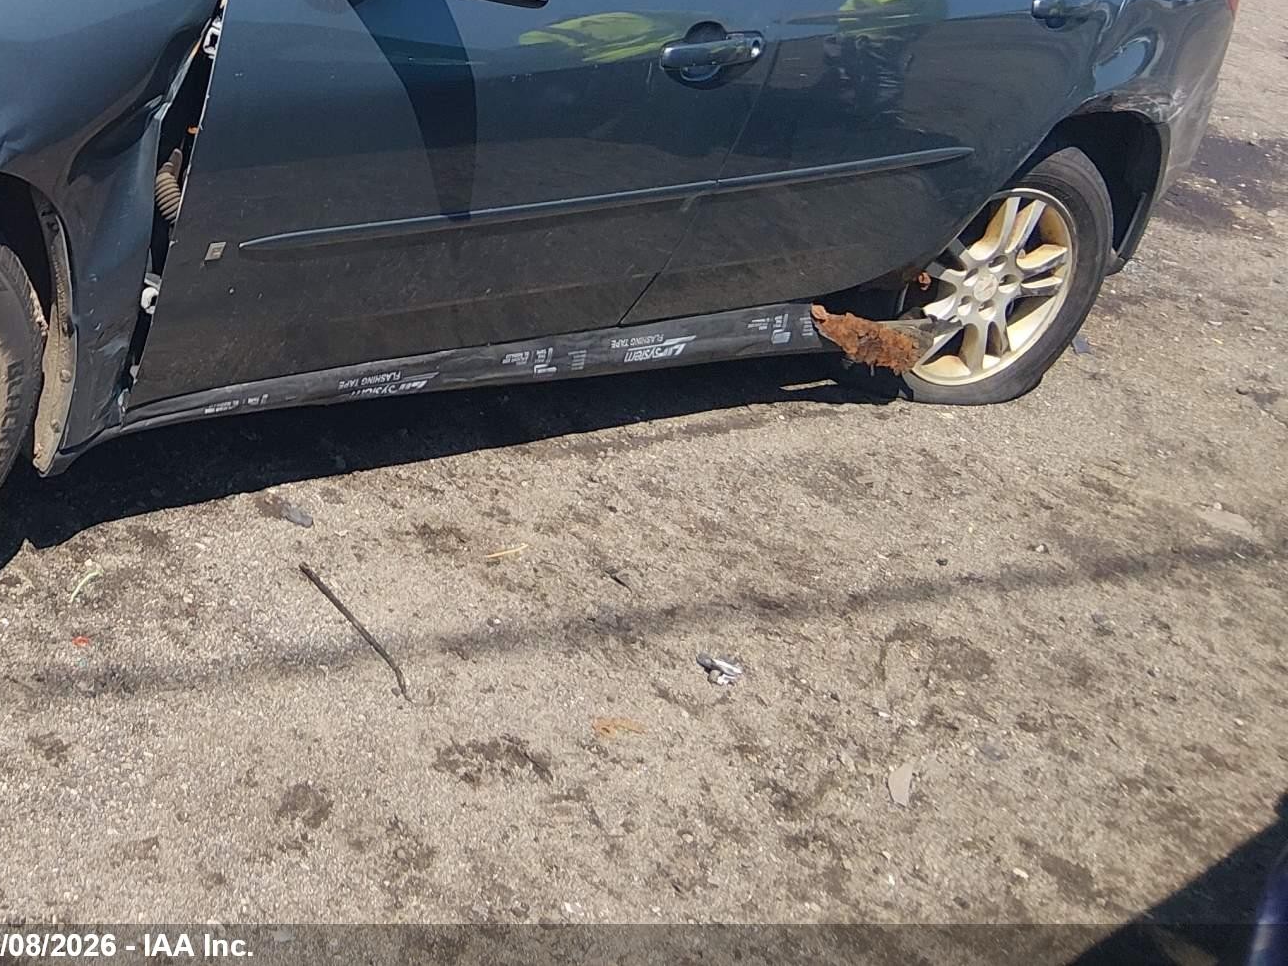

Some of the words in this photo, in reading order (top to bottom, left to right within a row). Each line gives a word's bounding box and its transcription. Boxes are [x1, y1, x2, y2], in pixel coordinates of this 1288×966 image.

[611, 338, 629, 349] TAPE
[629, 334, 664, 347] FLASHING
[338, 378, 360, 390] TAPE
[360, 370, 402, 387] FLASHING
